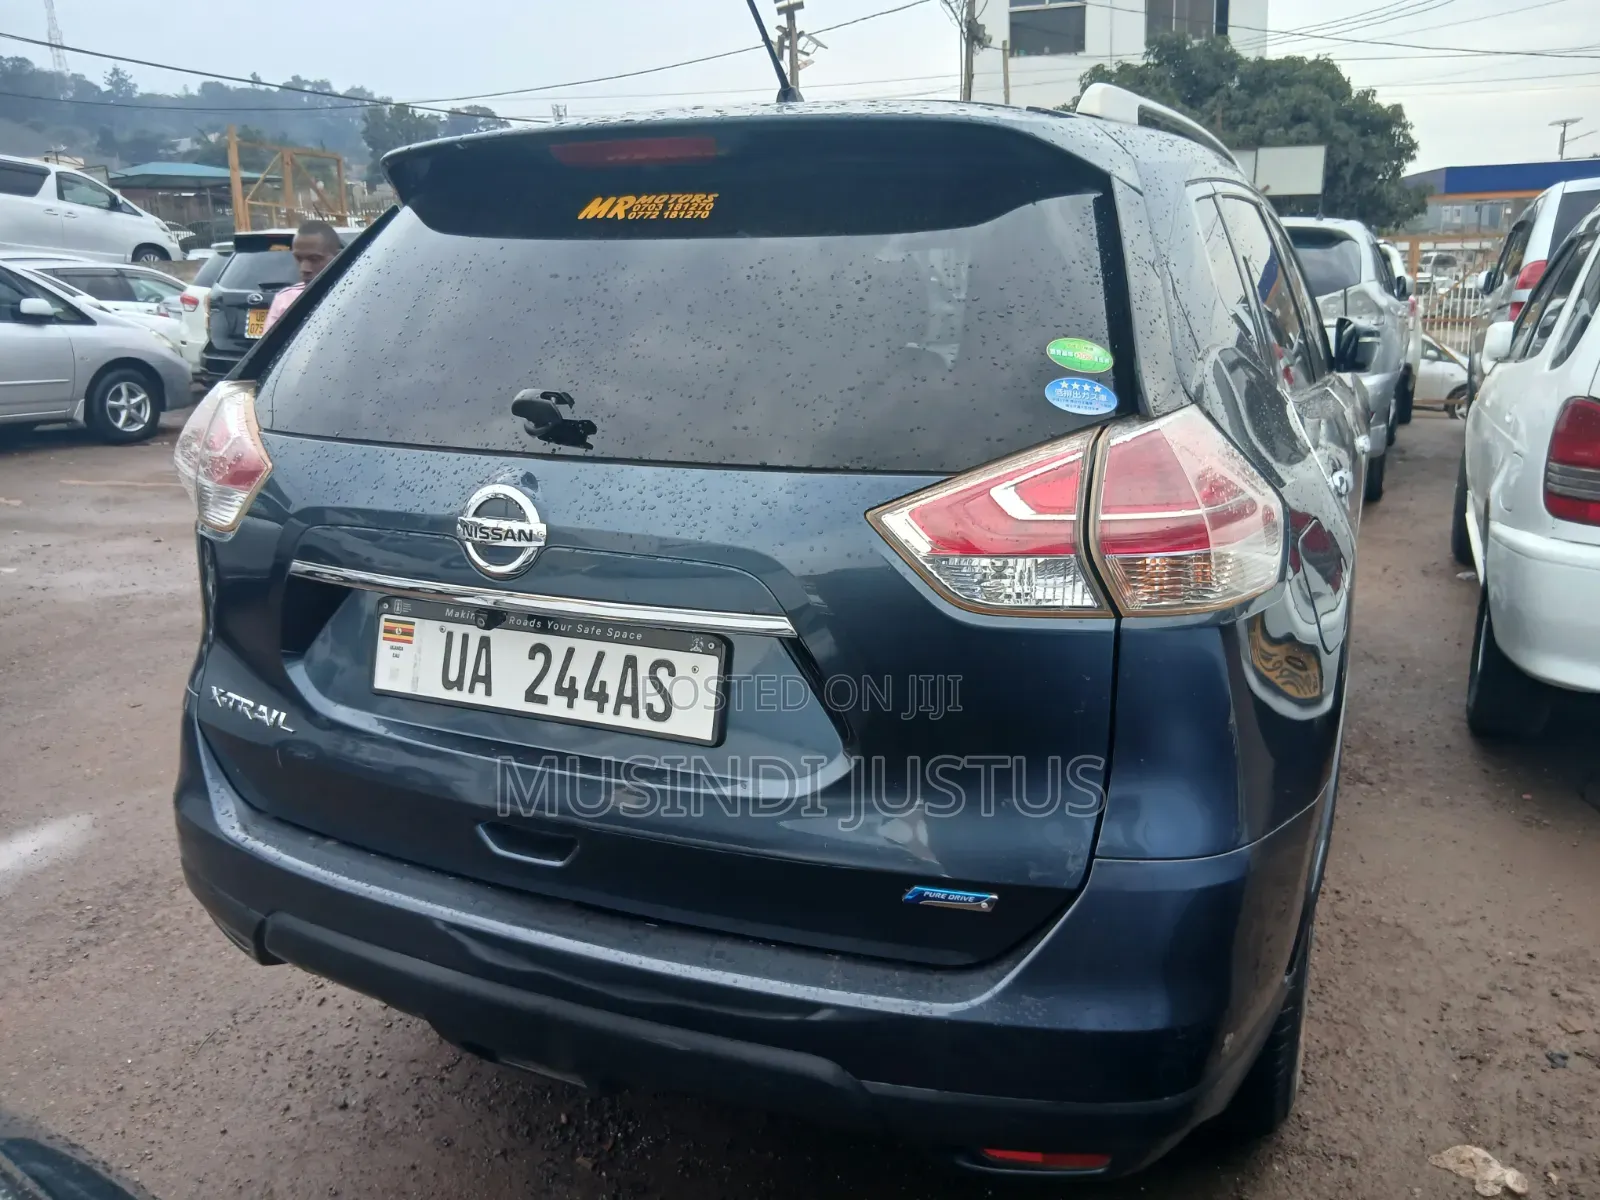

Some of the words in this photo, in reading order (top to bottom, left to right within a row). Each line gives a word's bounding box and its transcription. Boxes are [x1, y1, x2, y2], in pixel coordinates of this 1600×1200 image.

[578, 195, 637, 220] MR
[632, 203, 664, 212] 0703
[667, 202, 714, 211] 181270
[634, 193, 719, 204] MOTORS
[627, 211, 659, 220] 0772
[663, 210, 709, 219] 181270
[461, 524, 533, 543] NISSAN
[508, 615, 542, 629] Roads
[547, 619, 573, 632] Your
[576, 623, 602, 636] Safe
[606, 627, 643, 640] Space
[440, 630, 493, 697] UA
[524, 642, 677, 723] 244AS
[209, 685, 297, 733] X-TRAIL
[923, 890, 948, 900] PURE
[947, 894, 976, 903] DRIVE
